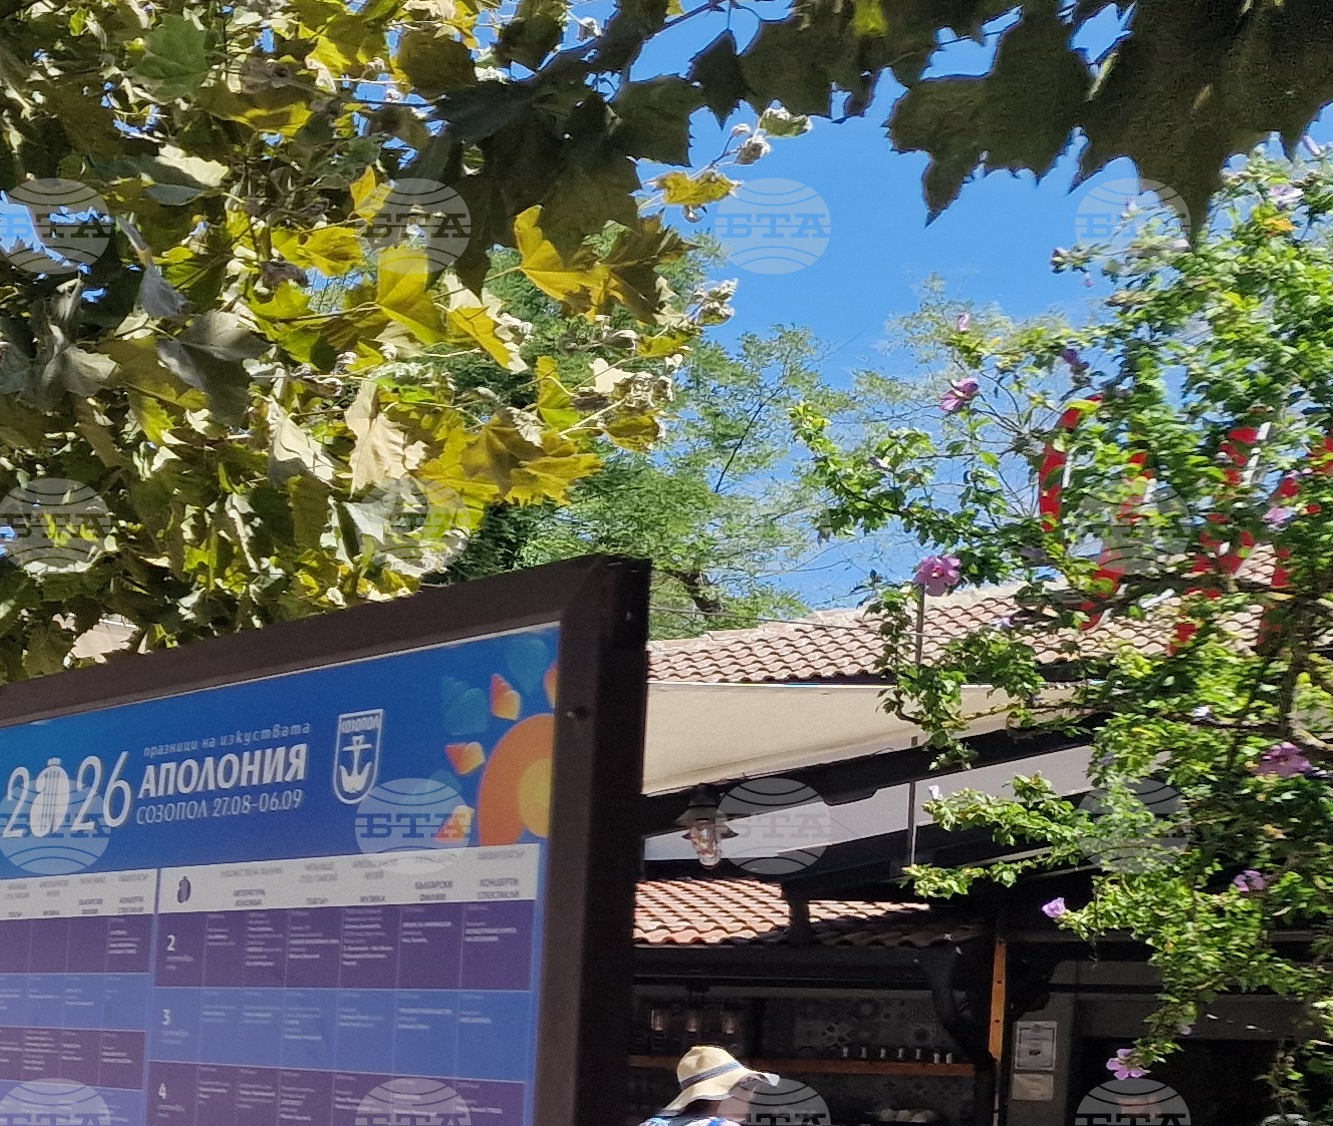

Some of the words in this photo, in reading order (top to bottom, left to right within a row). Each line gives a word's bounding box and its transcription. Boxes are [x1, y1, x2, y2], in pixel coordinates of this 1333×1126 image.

[143, 739, 198, 758] празници
[202, 736, 216, 749] на
[219, 722, 311, 746] изкуствата
[137, 743, 308, 799] АПОЛОНИЯ
[136, 800, 208, 825] СОЗОПОЛ
[166, 934, 176, 951] 2
[162, 1009, 171, 1025] 3
[157, 1083, 167, 1099] 4
